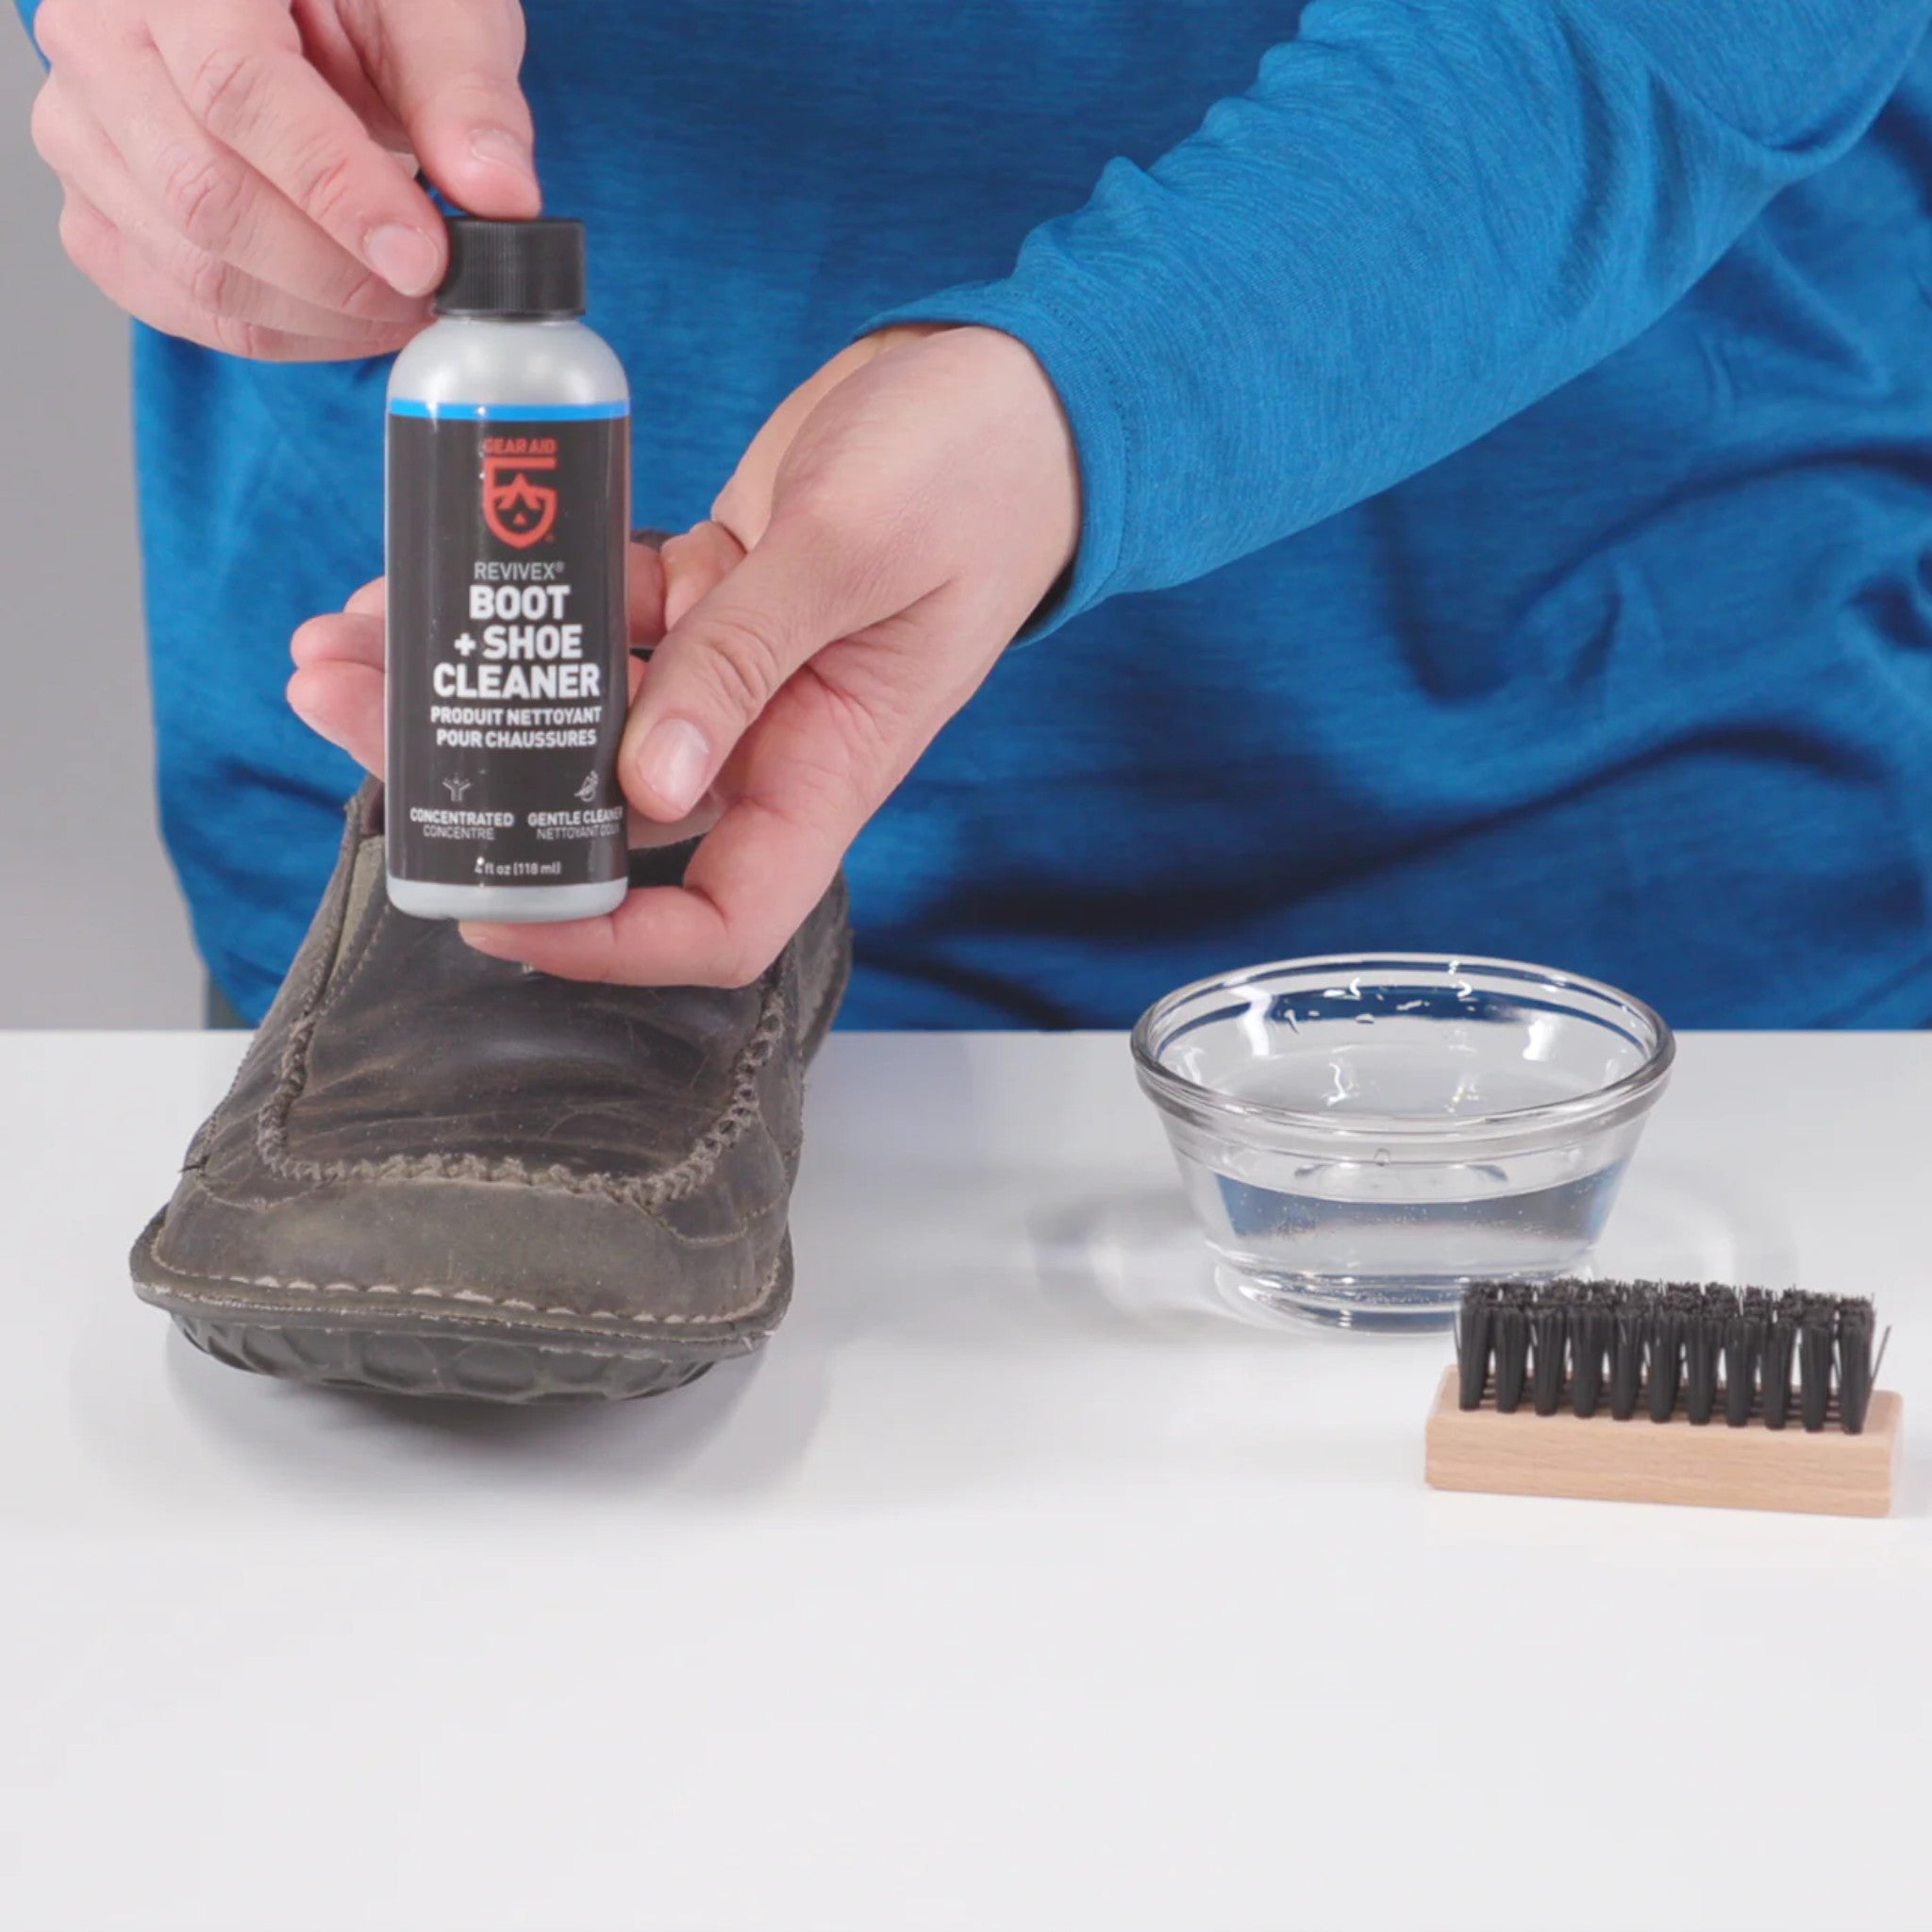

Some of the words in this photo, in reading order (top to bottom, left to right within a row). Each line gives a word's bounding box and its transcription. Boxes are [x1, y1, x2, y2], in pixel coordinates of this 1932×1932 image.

[483, 437, 526, 453] GEAR
[528, 437, 557, 453] AID
[469, 585, 570, 620] BOOT
[454, 632, 476, 657] +
[482, 624, 583, 659] SHOE
[433, 662, 601, 699] CLEANER
[430, 706, 505, 724] PRODUIT
[507, 707, 602, 725] NETTOYANT
[436, 728, 482, 747] POUR
[485, 728, 597, 748] CHAUSSURES
[409, 807, 514, 827] CONCENTRATED
[527, 810, 581, 827] GENTLE
[536, 824, 599, 841] NETTOYANT
[496, 864, 511, 875] oz
